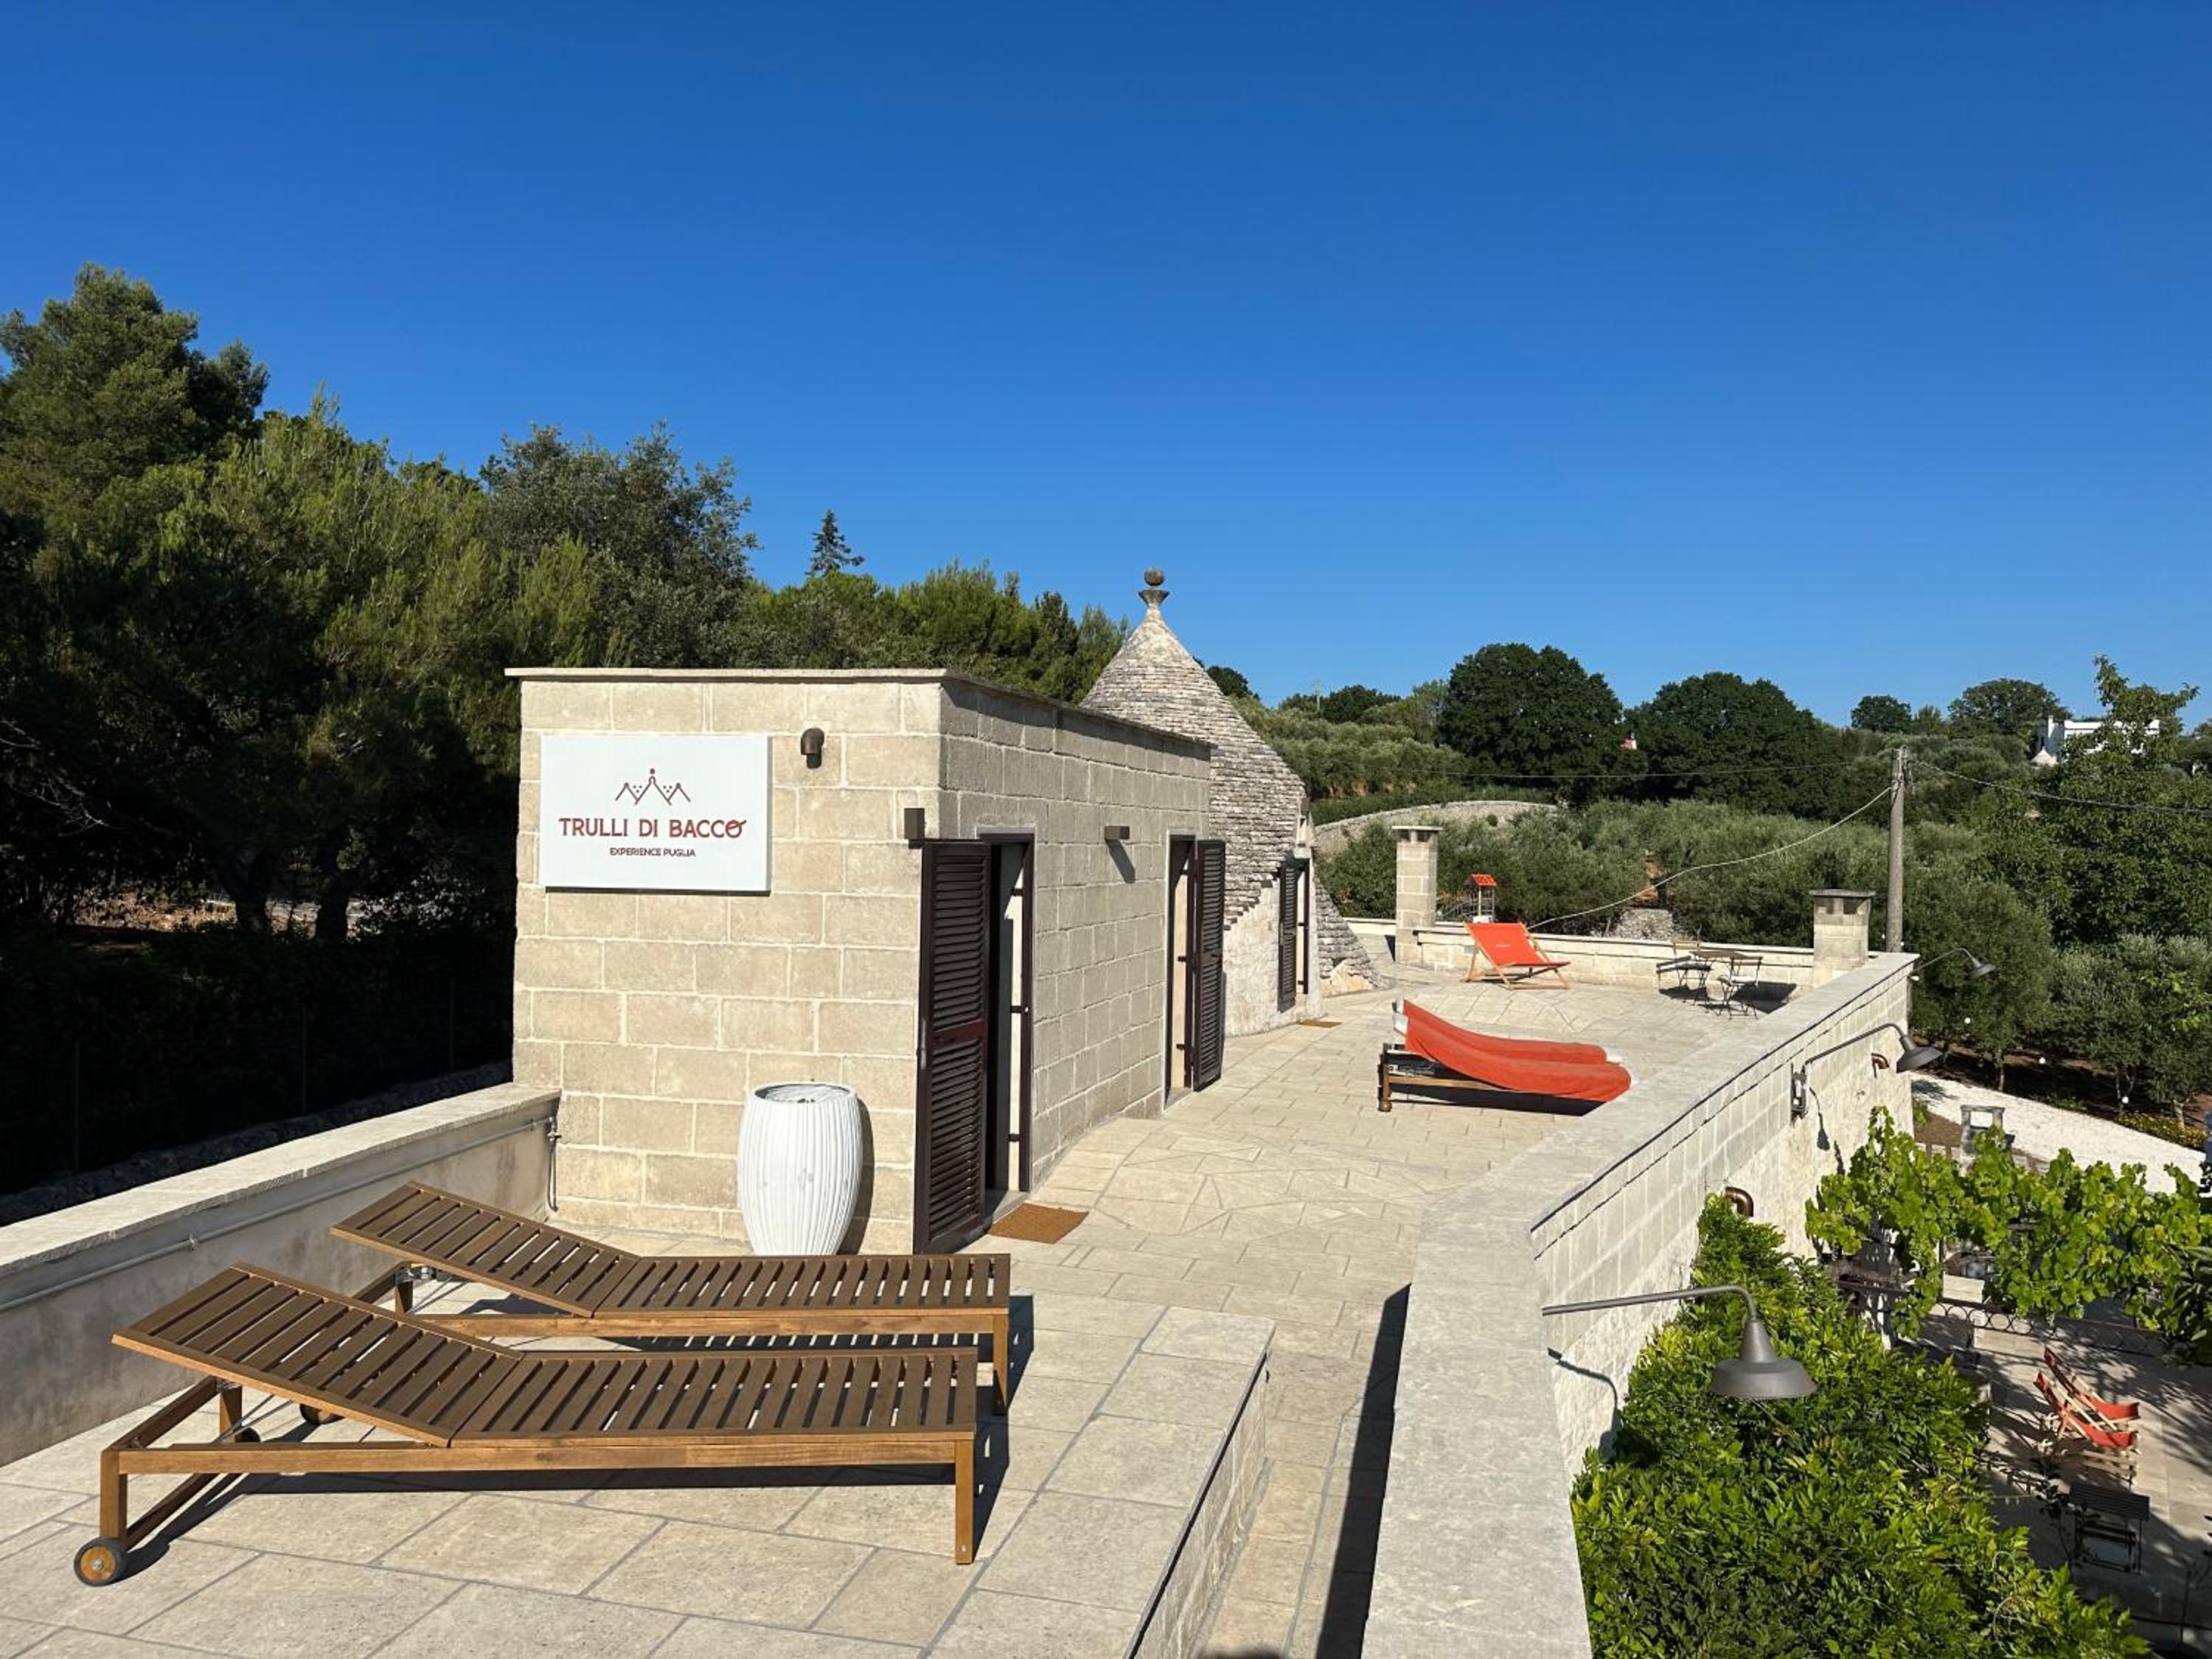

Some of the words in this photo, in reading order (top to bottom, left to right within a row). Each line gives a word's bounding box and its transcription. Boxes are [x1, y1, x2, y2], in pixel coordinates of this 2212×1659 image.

[559, 818, 628, 837] TRULLI
[639, 819, 658, 838] DI
[669, 819, 746, 838] BACCO
[610, 847, 661, 856] EXPERIENCE
[663, 848, 695, 857] PUGLIA
